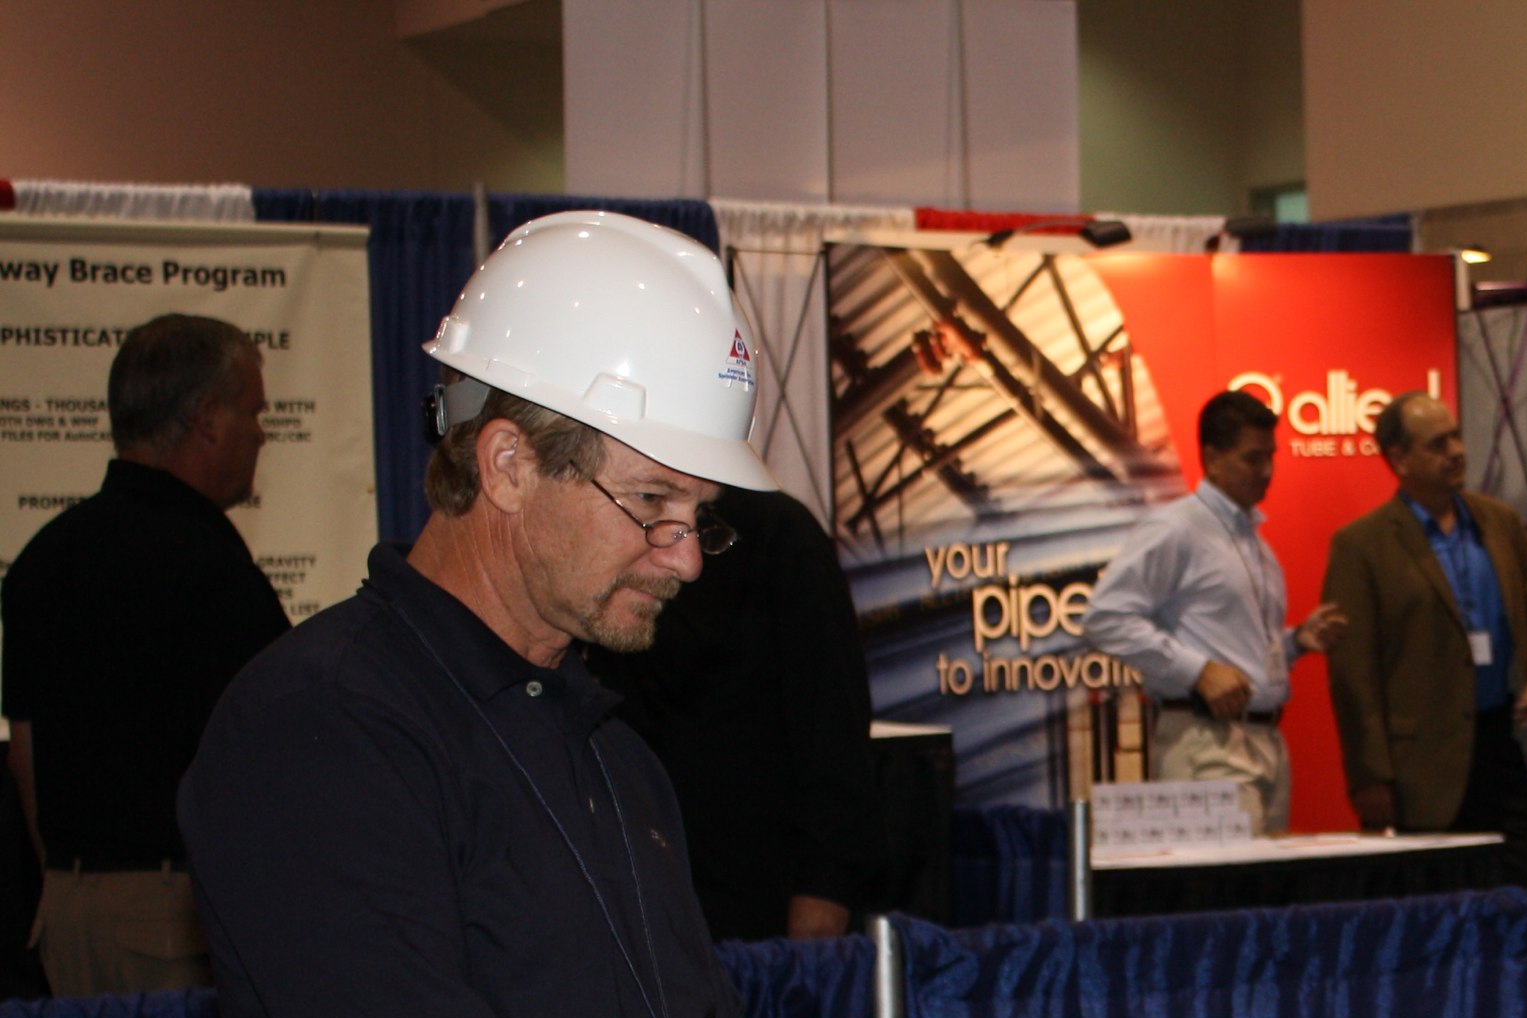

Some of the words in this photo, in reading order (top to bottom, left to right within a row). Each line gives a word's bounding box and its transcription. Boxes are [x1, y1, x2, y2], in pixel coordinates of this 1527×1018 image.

[69, 259, 152, 284] Brace
[162, 261, 286, 291] Program
[0, 327, 132, 347] PHISTICAT
[1290, 440, 1336, 456] TUBE
[925, 541, 1010, 589] your
[937, 653, 973, 695] to
